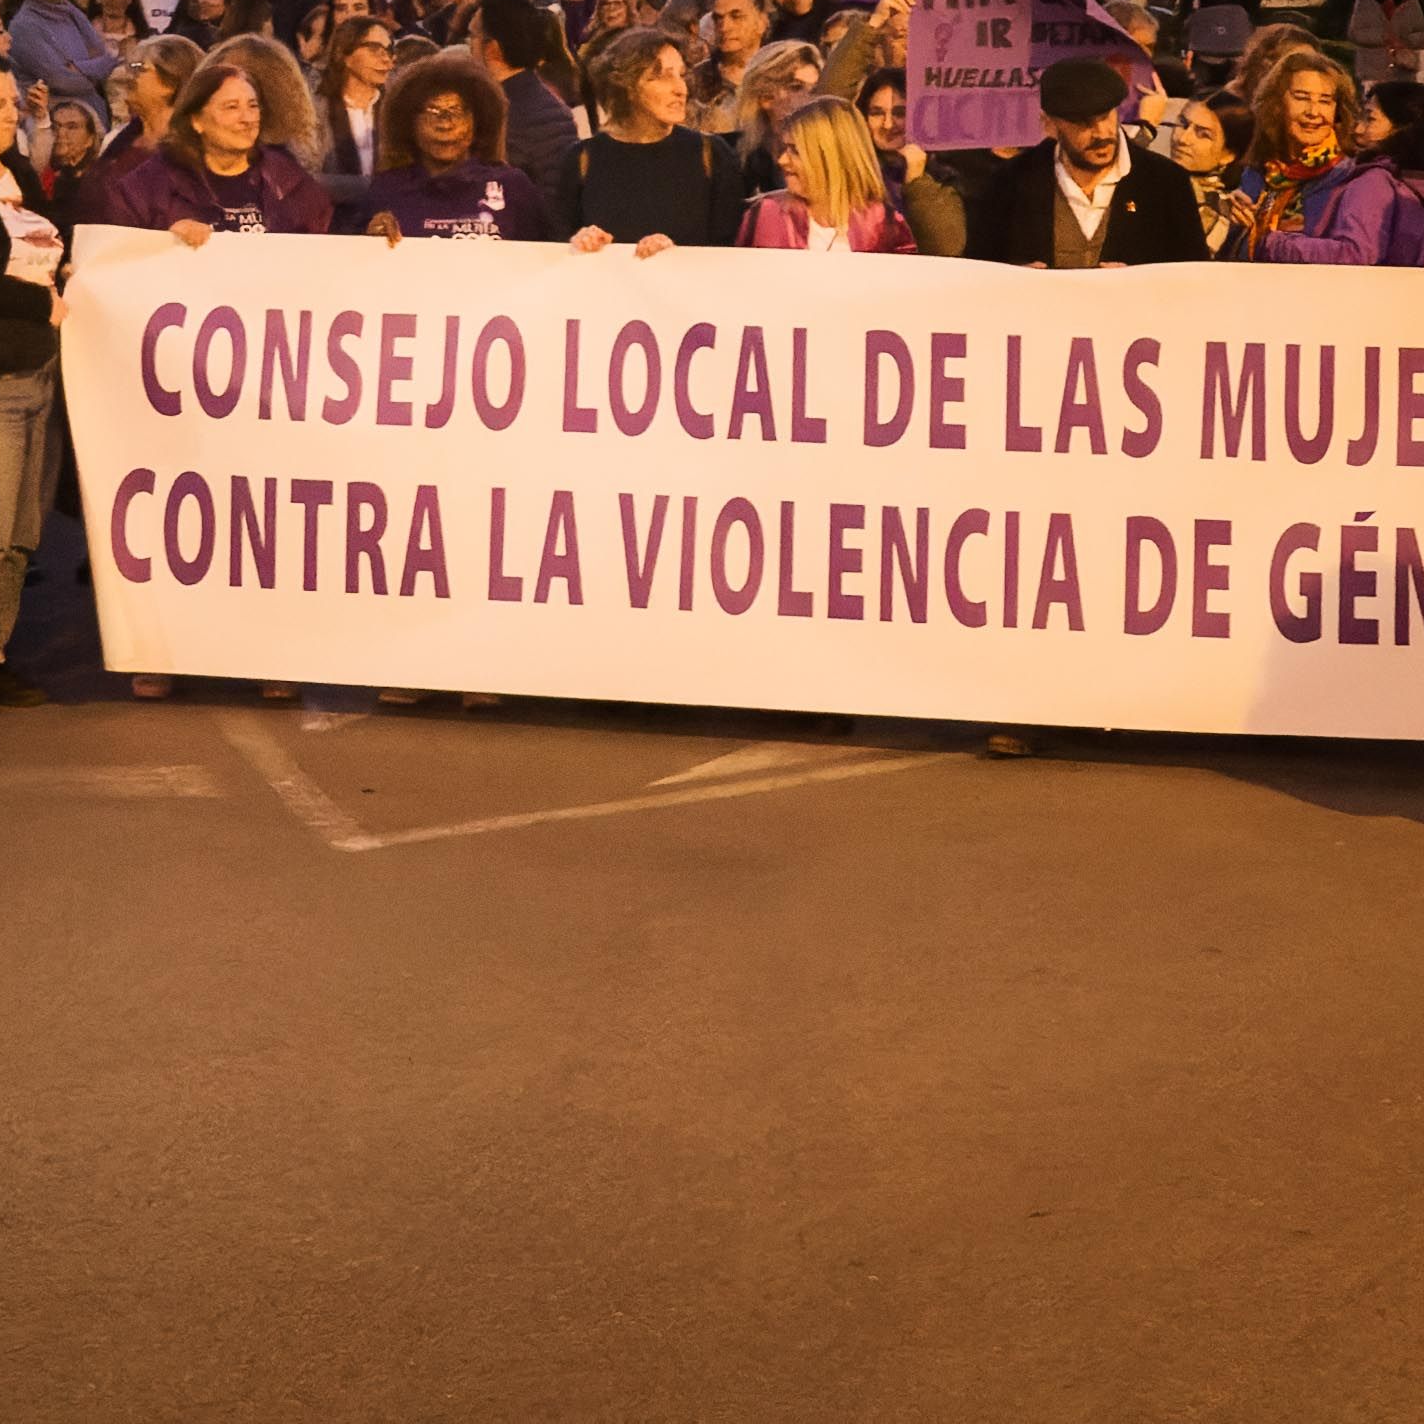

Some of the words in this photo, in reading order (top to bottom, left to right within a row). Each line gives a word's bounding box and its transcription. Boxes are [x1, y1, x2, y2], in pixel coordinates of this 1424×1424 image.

[925, 66, 1043, 89] HUELLAS
[976, 17, 1013, 49] IR
[141, 302, 525, 431] CONSEJO
[562, 319, 827, 444] LOCAL
[863, 329, 967, 450] DE
[1005, 335, 1163, 459] LAS
[110, 467, 451, 599] CONTRA
[487, 487, 584, 606] LA
[618, 493, 1085, 632] VIOLENCIA
[1123, 515, 1232, 639] DE
